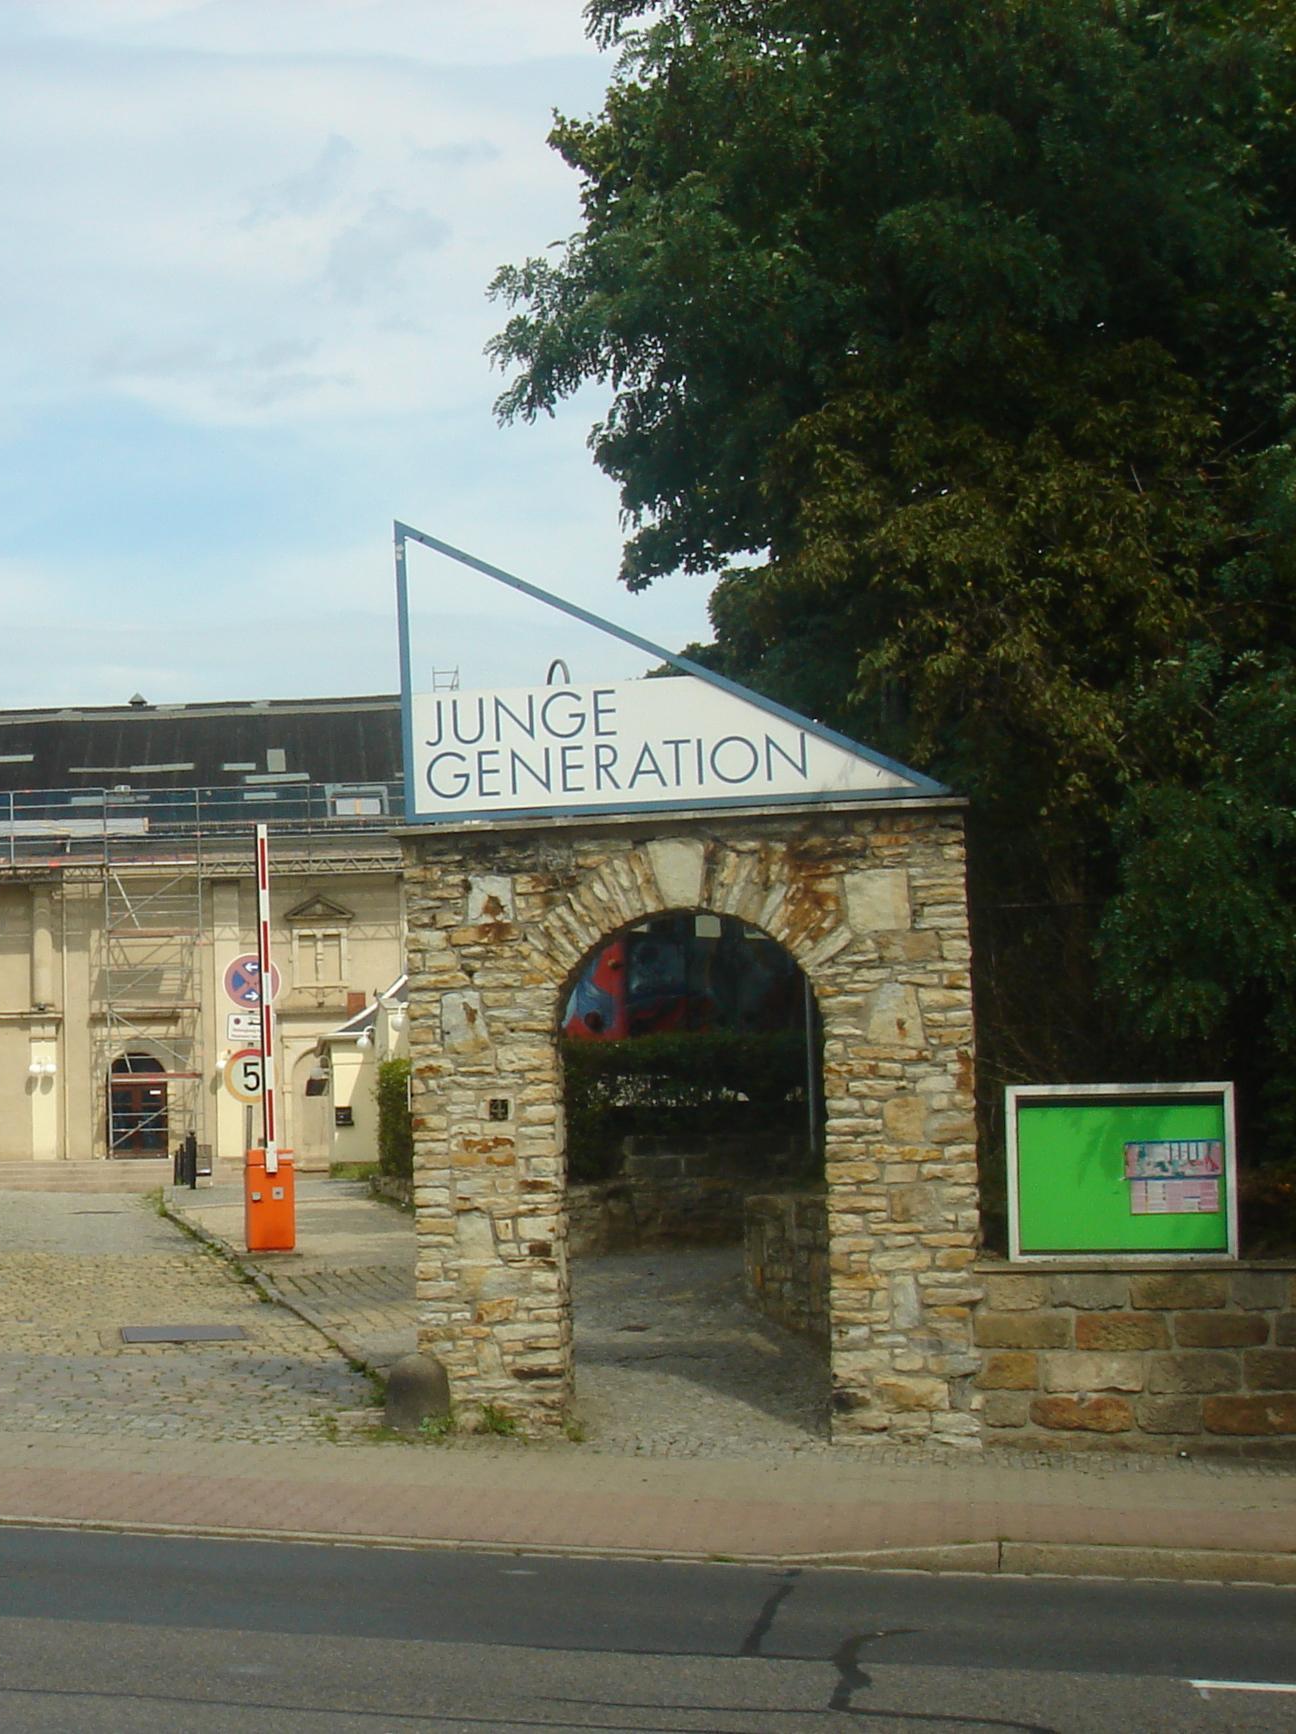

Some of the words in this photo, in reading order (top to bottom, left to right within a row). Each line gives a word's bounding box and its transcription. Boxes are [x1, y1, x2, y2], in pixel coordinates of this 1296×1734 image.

[426, 689, 617, 747] JUNGE
[426, 732, 807, 799] GENERATION
[243, 1061, 260, 1092] 5
